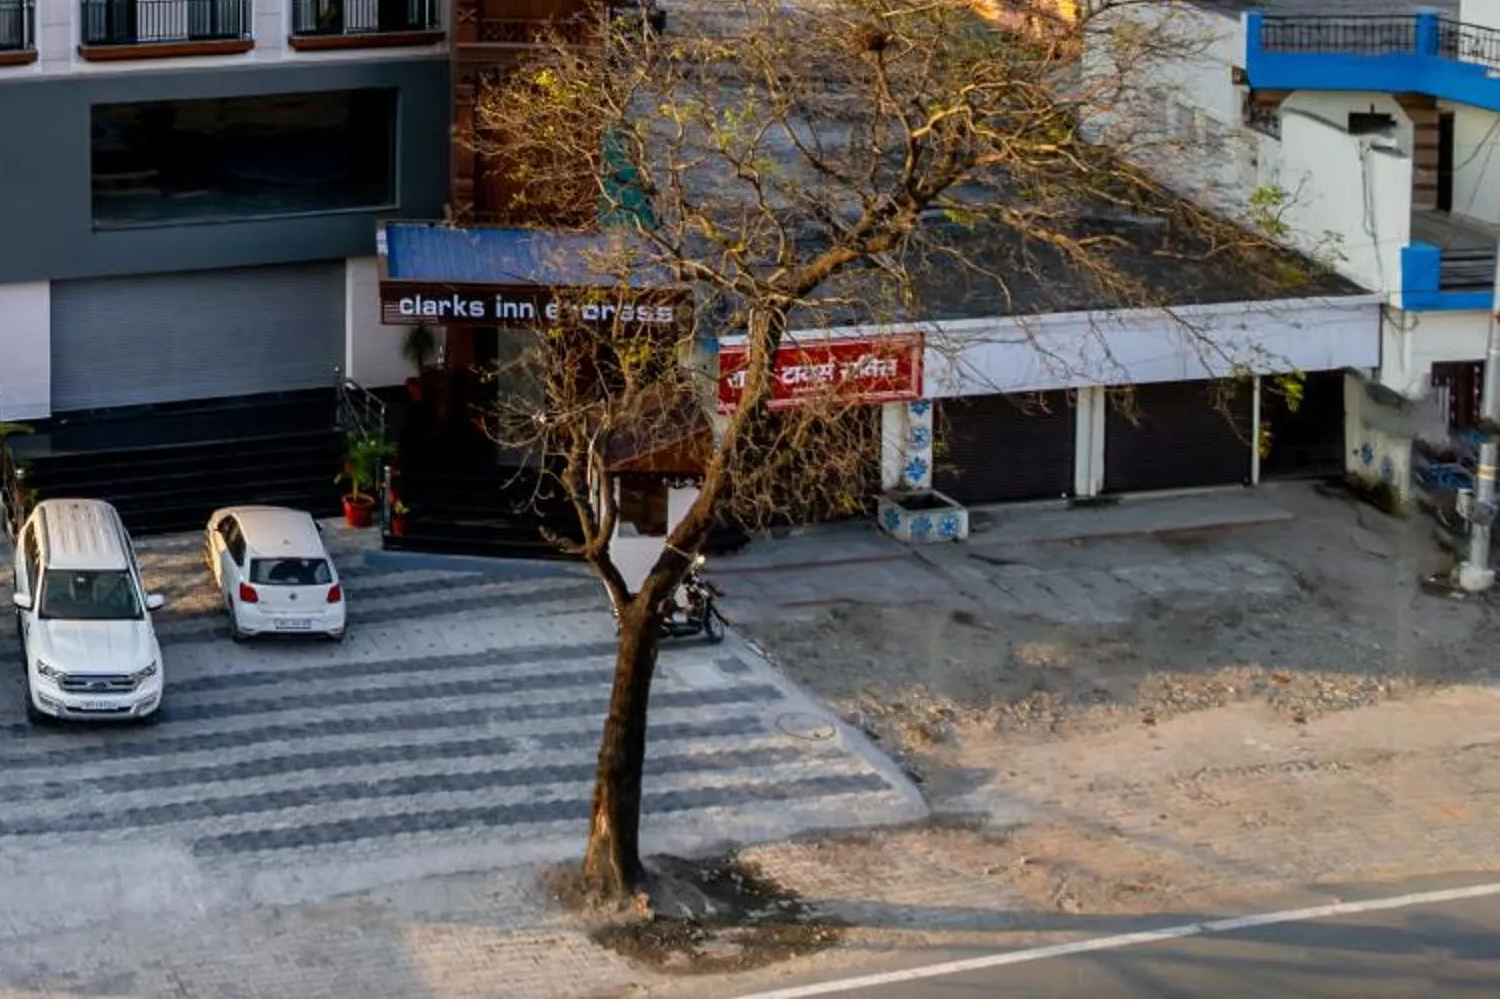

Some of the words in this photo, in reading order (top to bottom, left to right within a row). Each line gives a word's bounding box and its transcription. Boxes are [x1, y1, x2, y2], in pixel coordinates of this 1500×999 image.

[399, 294, 485, 317] clarks
[496, 296, 534, 319] inn
[545, 301, 674, 324] epress
